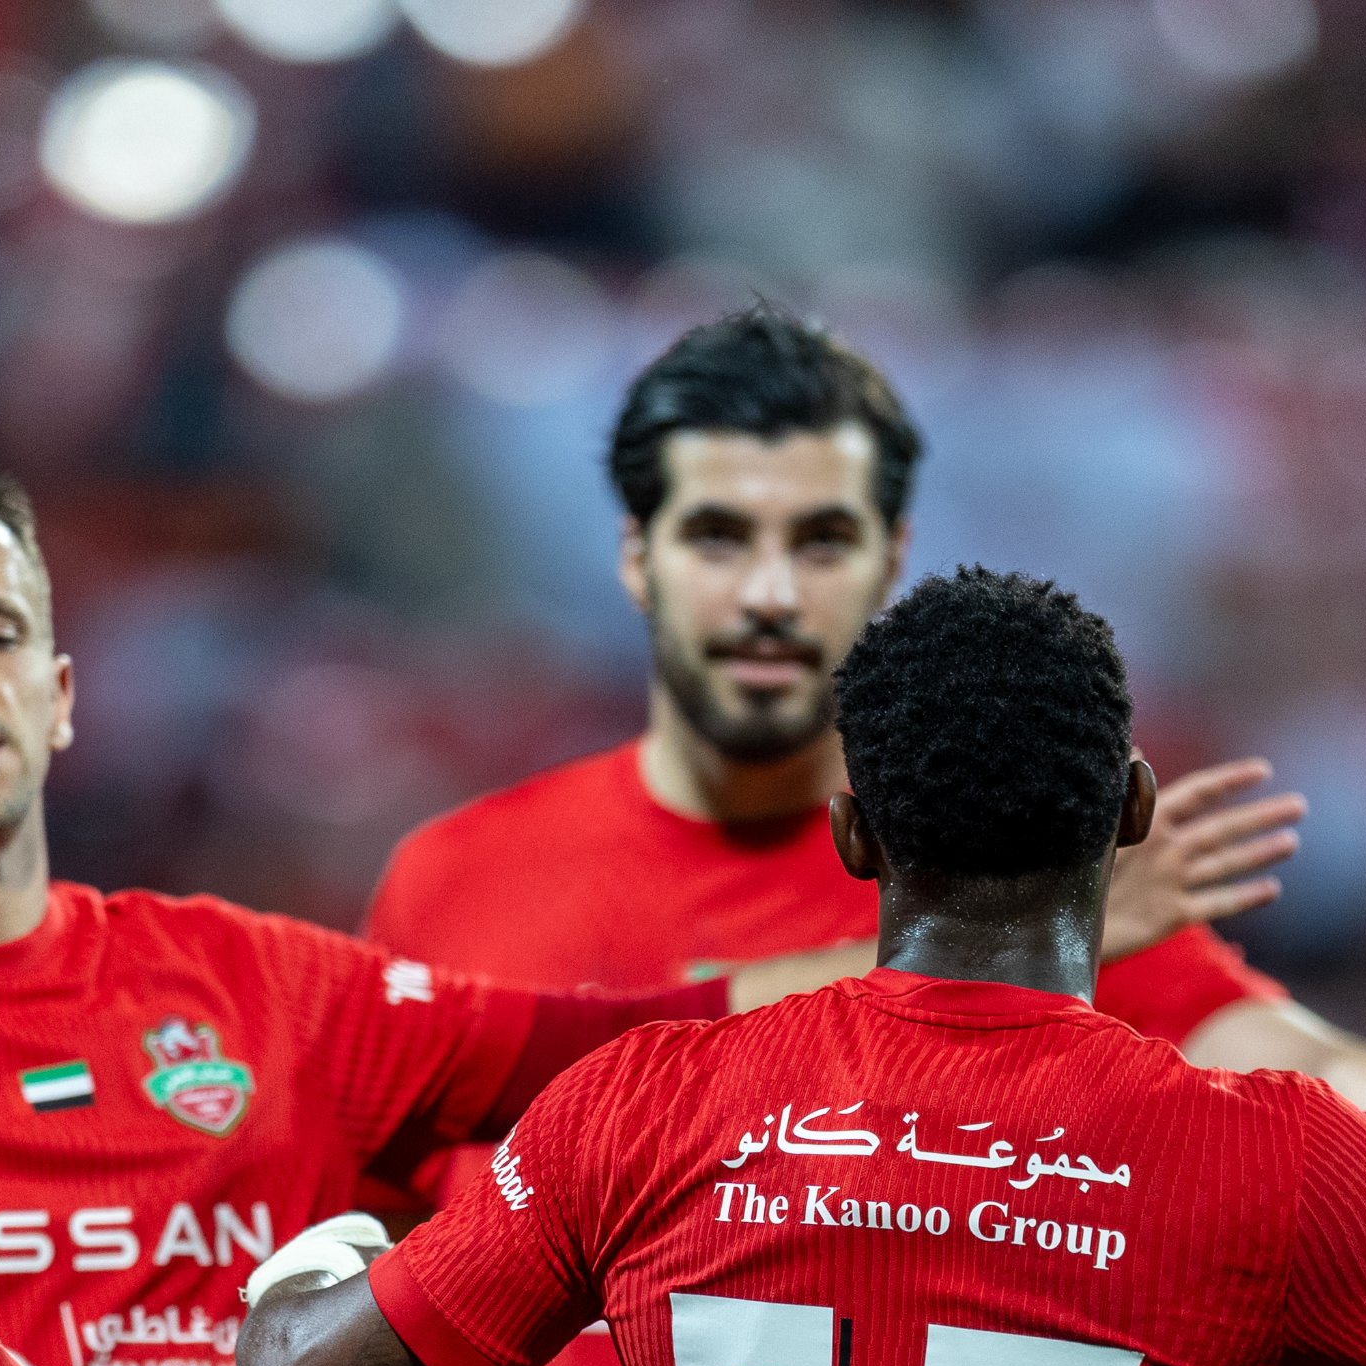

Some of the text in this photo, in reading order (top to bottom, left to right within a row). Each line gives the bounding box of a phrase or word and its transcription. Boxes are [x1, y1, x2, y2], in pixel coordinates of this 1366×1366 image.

[713, 1182, 1126, 1271] The Kanoo Group
